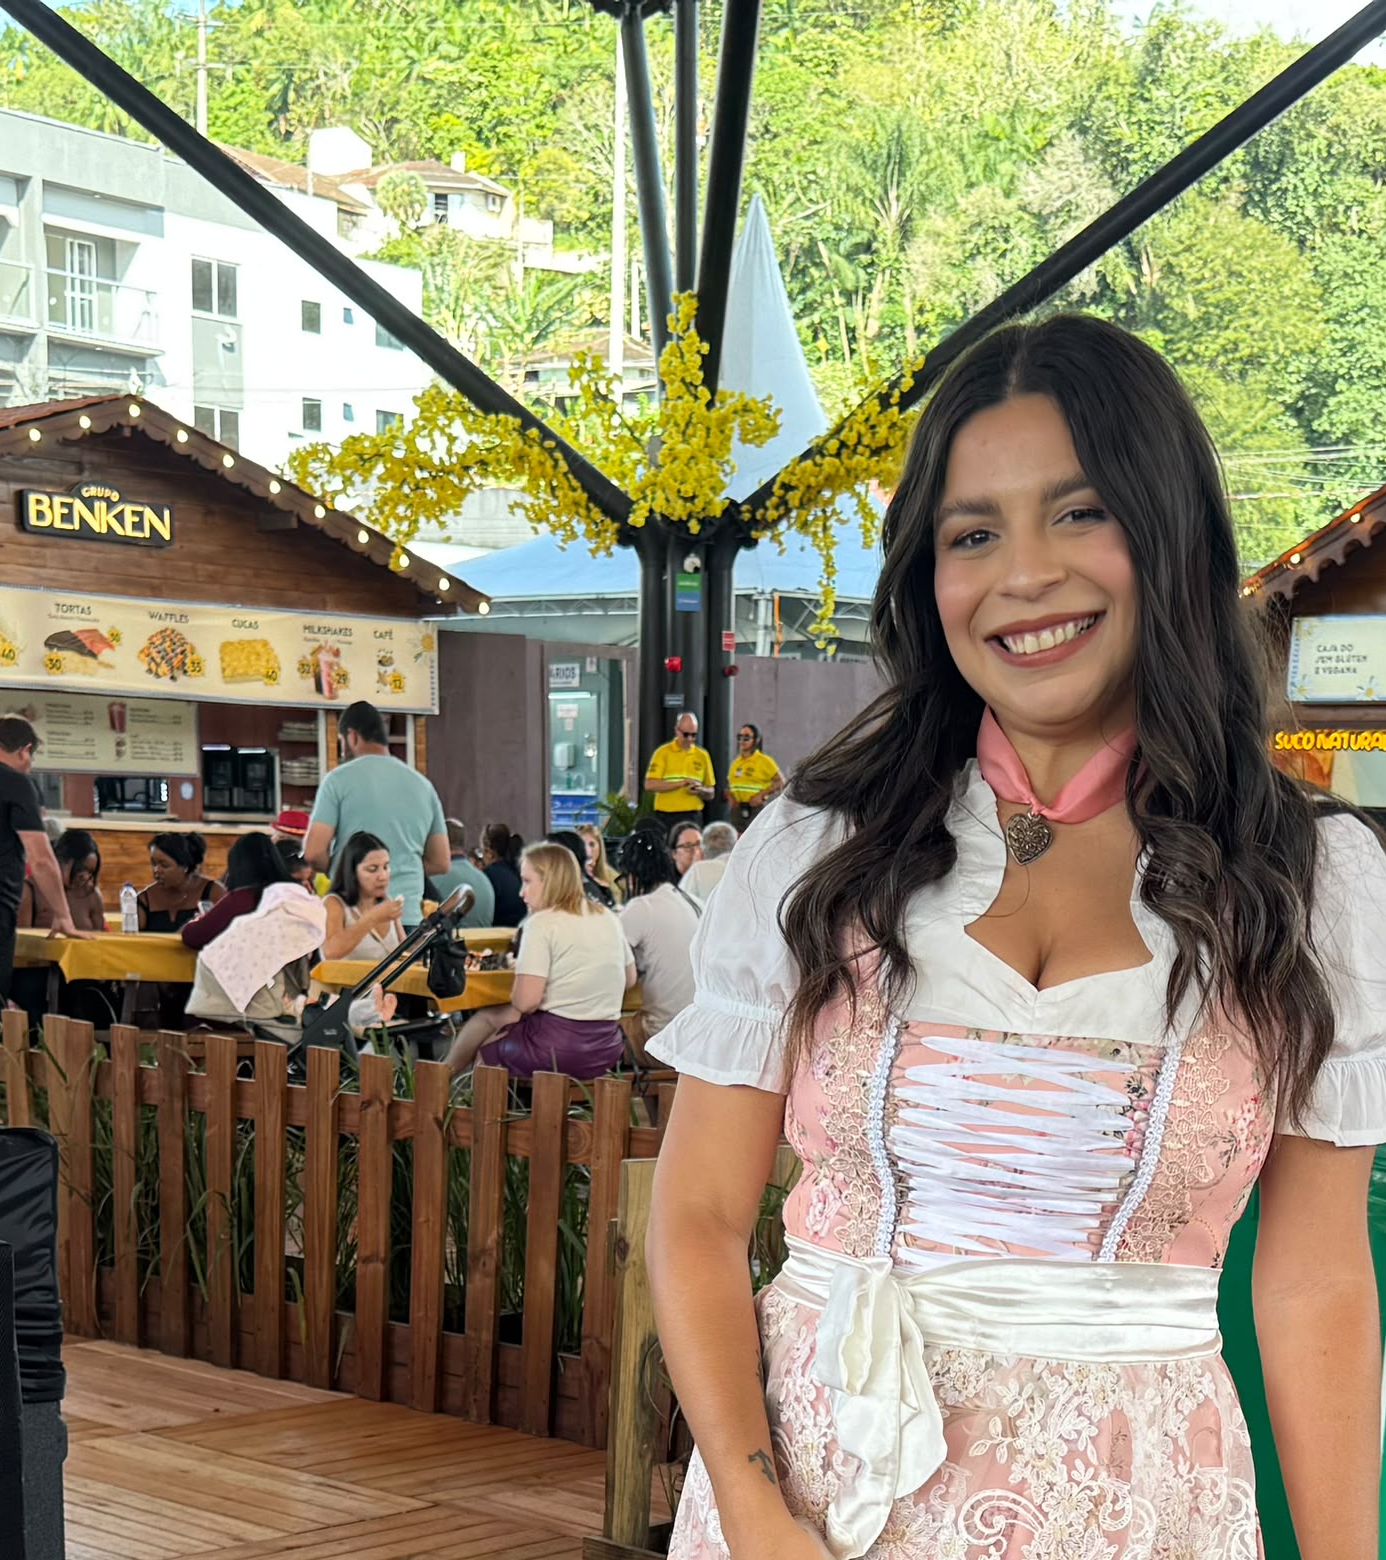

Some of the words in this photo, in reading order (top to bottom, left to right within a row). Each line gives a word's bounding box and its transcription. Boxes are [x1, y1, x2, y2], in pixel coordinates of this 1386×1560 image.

[80, 485, 120, 502] GRUPO
[28, 493, 171, 541] BENKEN
[54, 603, 92, 615] TORTAS
[148, 611, 189, 624] WAFFLES
[231, 618, 259, 630] CUCAS
[303, 625, 353, 637] MILKSHAKES
[373, 629, 394, 641] CAFÉ
[1274, 730, 1316, 751] SUCO
